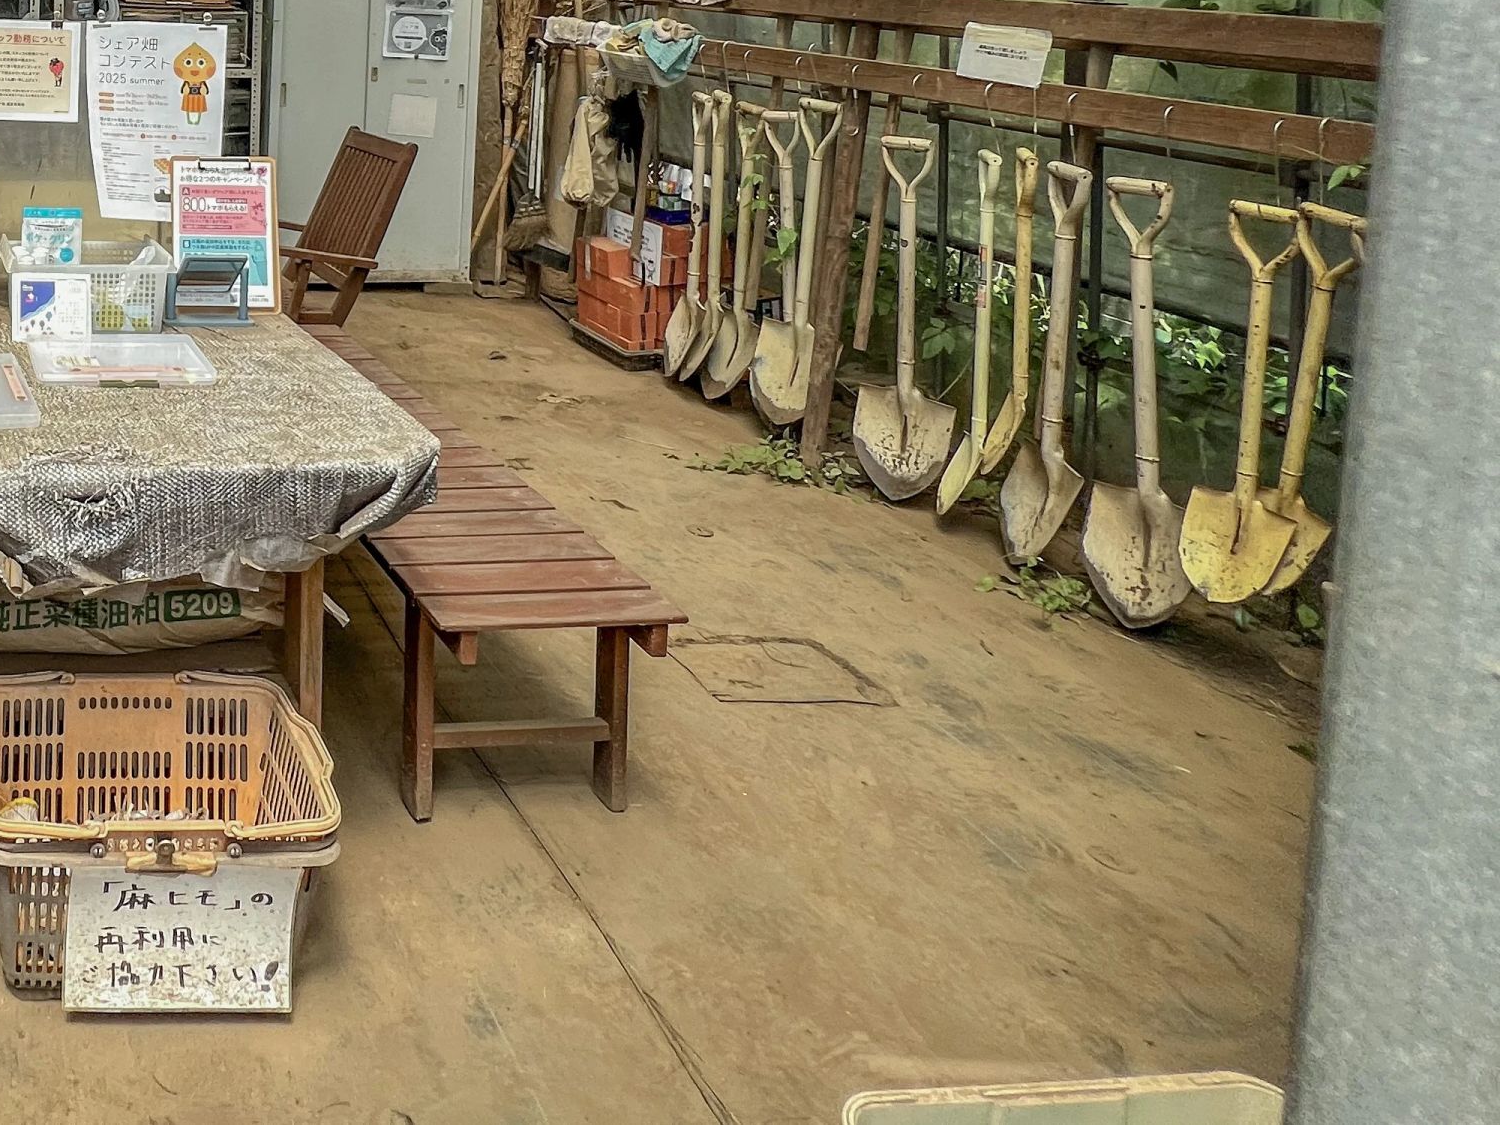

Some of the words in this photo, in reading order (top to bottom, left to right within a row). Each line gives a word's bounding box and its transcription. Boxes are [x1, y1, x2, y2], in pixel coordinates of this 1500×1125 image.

[99, 36, 159, 51] シェア畑
[99, 54, 171, 69] コンテスト
[99, 72, 127, 84] 2025
[129, 77, 165, 86] summer
[182, 197, 207, 212] 800
[169, 592, 235, 619] 5209
[103, 880, 274, 912] 「麻ヒモ」の
[94, 926, 221, 954] 再利用に
